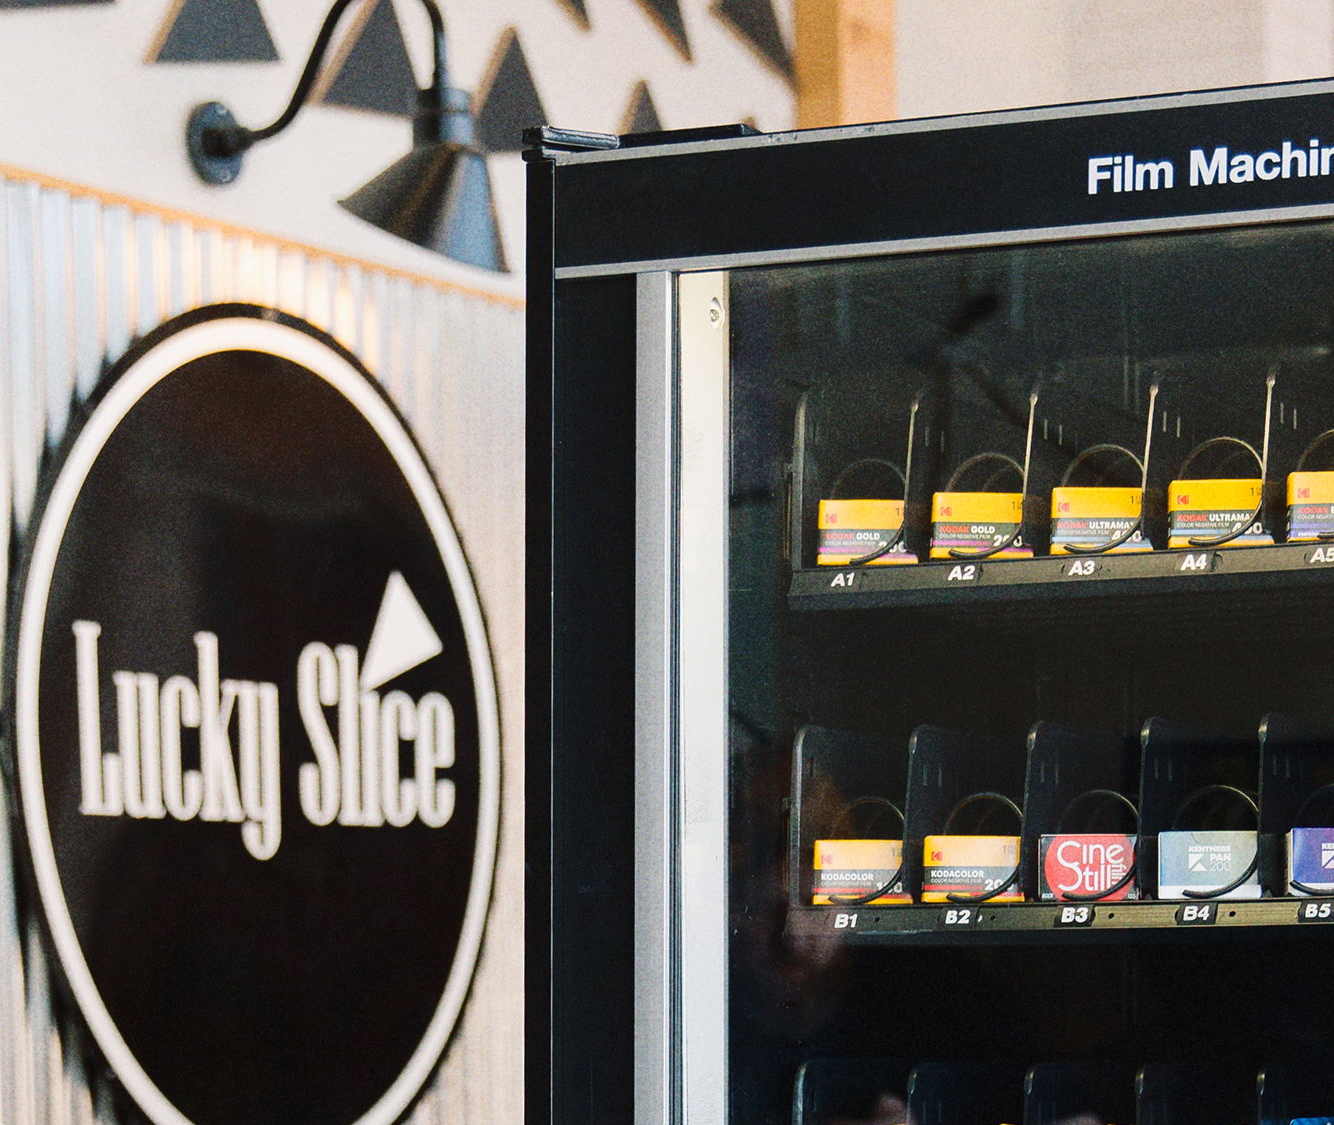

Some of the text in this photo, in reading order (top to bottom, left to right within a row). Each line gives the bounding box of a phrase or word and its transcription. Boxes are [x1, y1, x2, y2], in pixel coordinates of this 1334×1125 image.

[1088, 155, 1174, 195] Film
[1297, 506, 1329, 514] KODAK
[1177, 514, 1207, 522] KODAK
[856, 532, 880, 541] GOLD
[971, 525, 995, 534] GOLD
[1068, 560, 1096, 576] A3
[1181, 554, 1208, 571] A4
[830, 572, 855, 588] A1
[947, 565, 975, 581] A2
[72, 620, 456, 860] Lucky Slice
[1057, 840, 1125, 869] Cine
[1210, 853, 1232, 861] PAN
[1210, 862, 1232, 872] 200
[821, 873, 874, 881] KODACOLOR
[931, 870, 984, 879] KODACOLOR
[945, 910, 970, 924] B2
[1061, 907, 1088, 923] B3
[1183, 905, 1210, 920] B4
[1305, 903, 1331, 918] B5
[834, 914, 858, 928] B1
